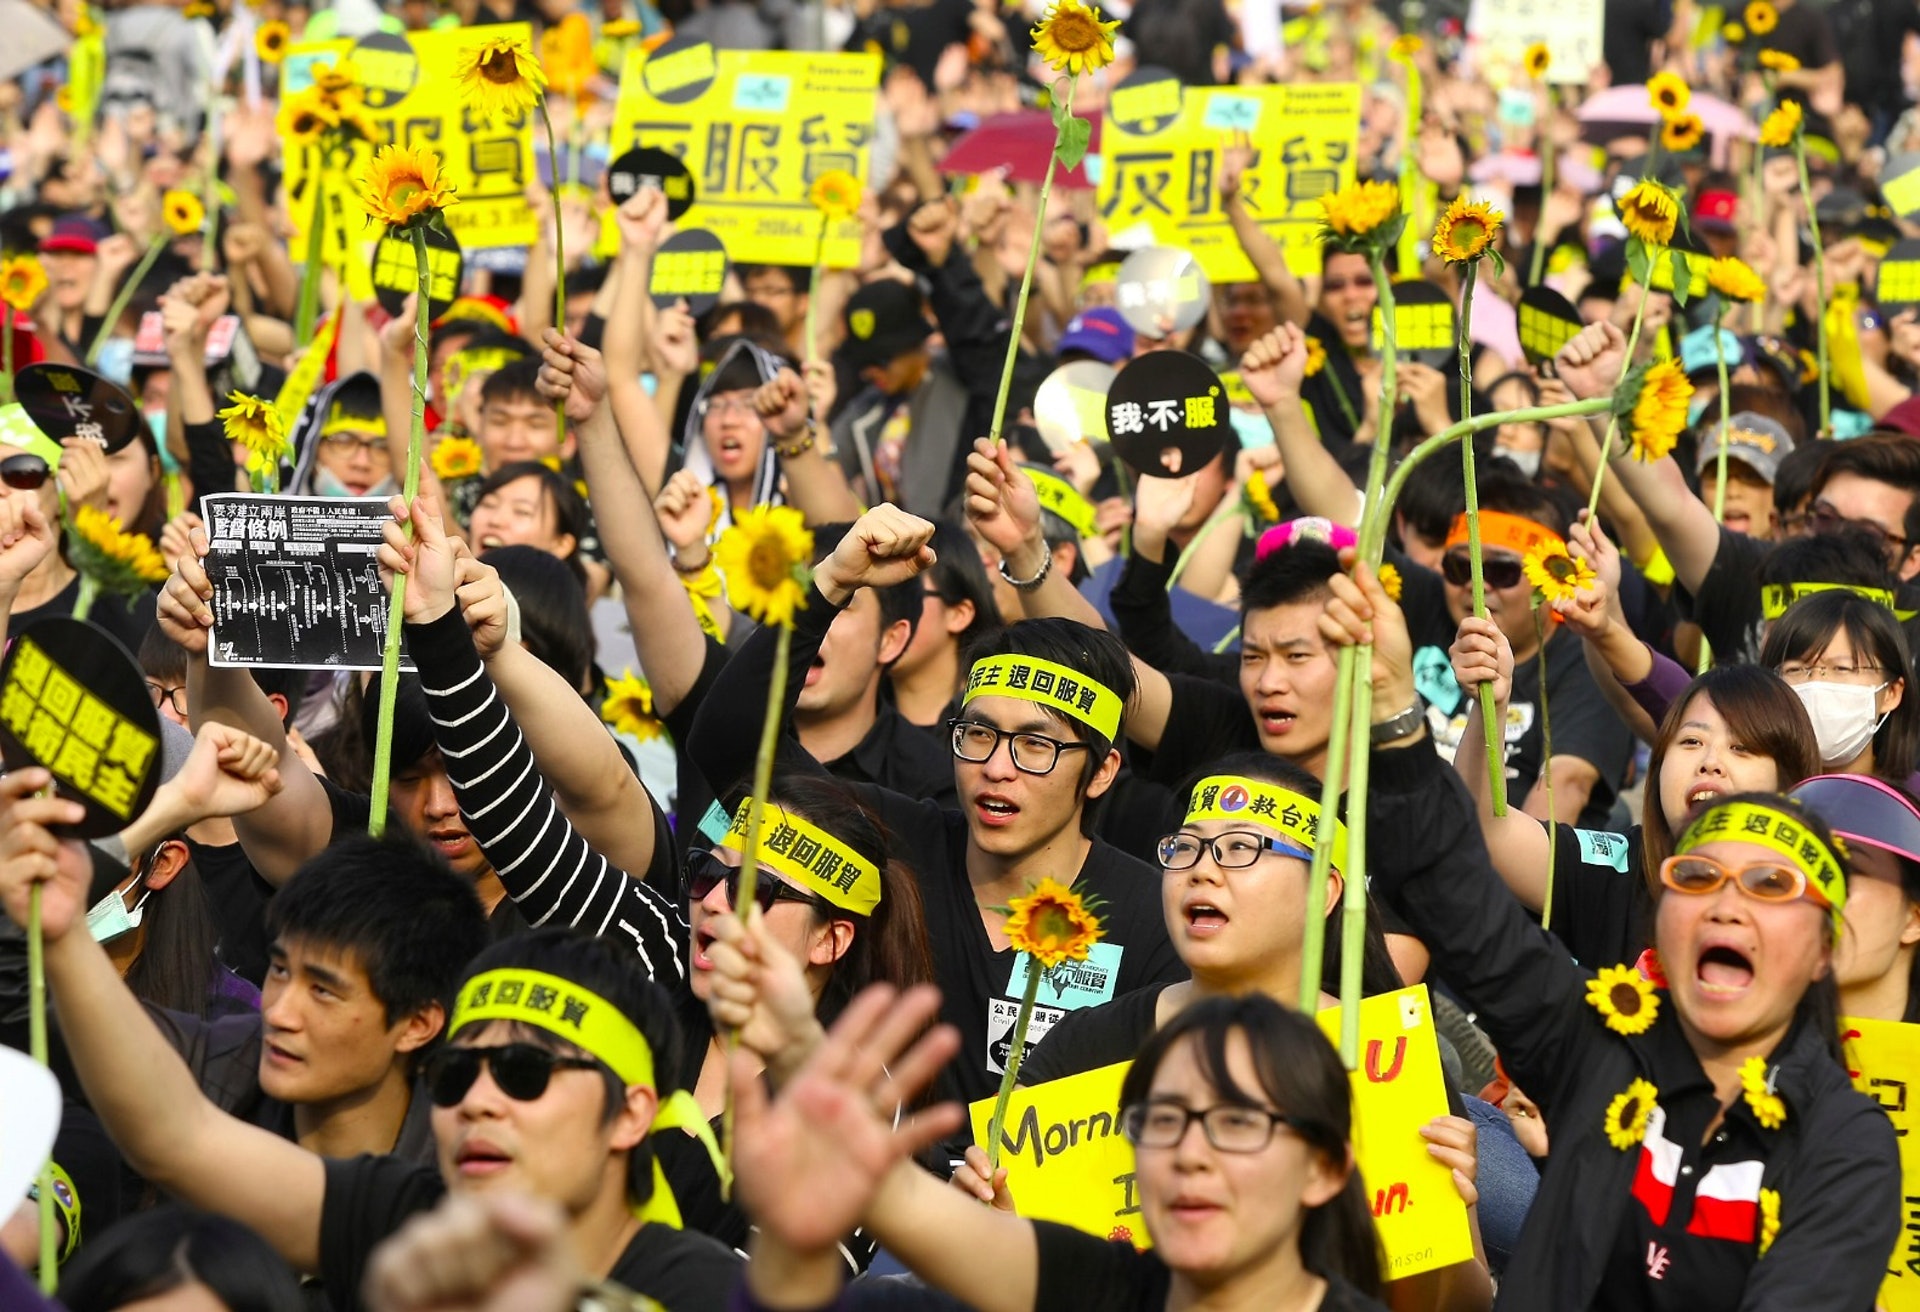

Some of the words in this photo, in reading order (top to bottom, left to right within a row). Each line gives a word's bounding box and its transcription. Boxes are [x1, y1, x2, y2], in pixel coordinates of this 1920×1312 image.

[212, 503, 287, 520] 要求建立兩岸
[212, 518, 289, 541] 監督條例
[1006, 664, 1097, 715] 退回服貿
[763, 823, 862, 895] 退回服貿
[1742, 812, 1836, 889] 退回服貿
[470, 980, 590, 1031] 退回服貿
[994, 1003, 1060, 1024] 公民服從
[1365, 1036, 1408, 1083] U
